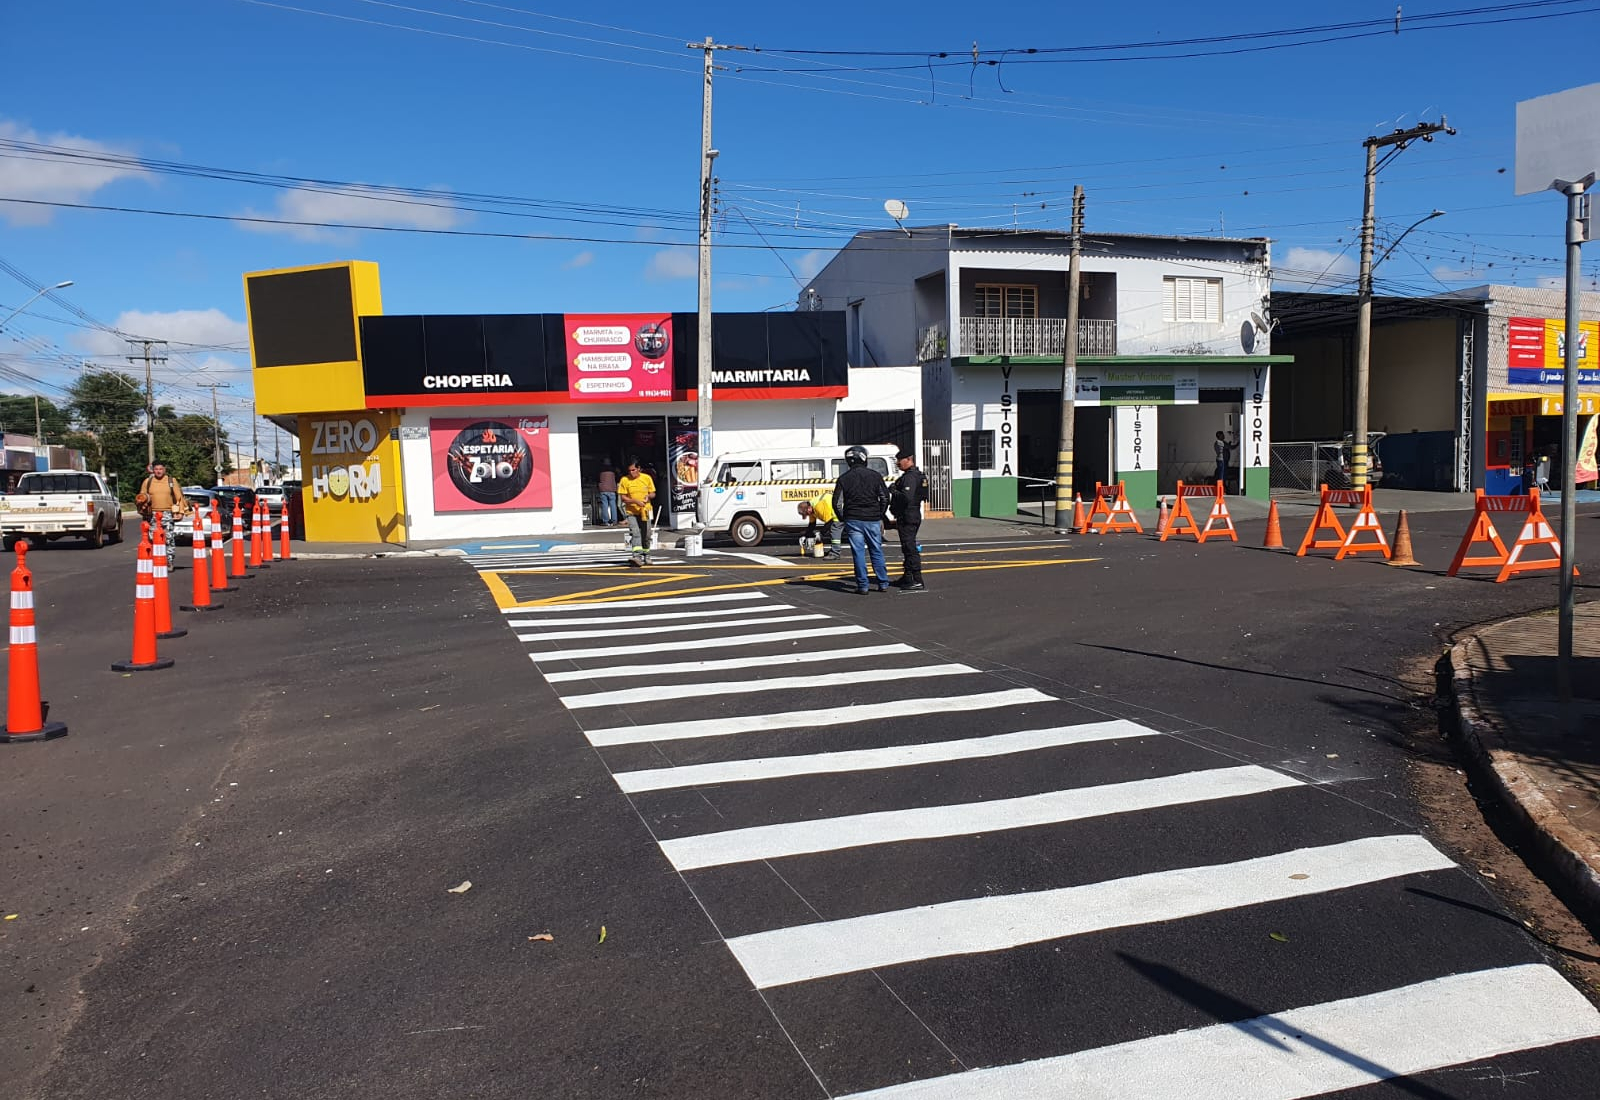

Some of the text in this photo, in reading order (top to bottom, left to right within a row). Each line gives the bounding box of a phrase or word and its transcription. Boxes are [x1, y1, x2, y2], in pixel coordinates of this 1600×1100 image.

[423, 374, 514, 389] CHOPERIA
[711, 369, 810, 383] MARMITARIA
[1001, 366, 1012, 476] VISTORIA
[1253, 368, 1262, 467] VISTORIA
[311, 419, 379, 455] ZERO
[463, 444, 515, 454] ESPETARIA
[1133, 405, 1142, 470] VISTORIA
[312, 463, 382, 499] HORA
